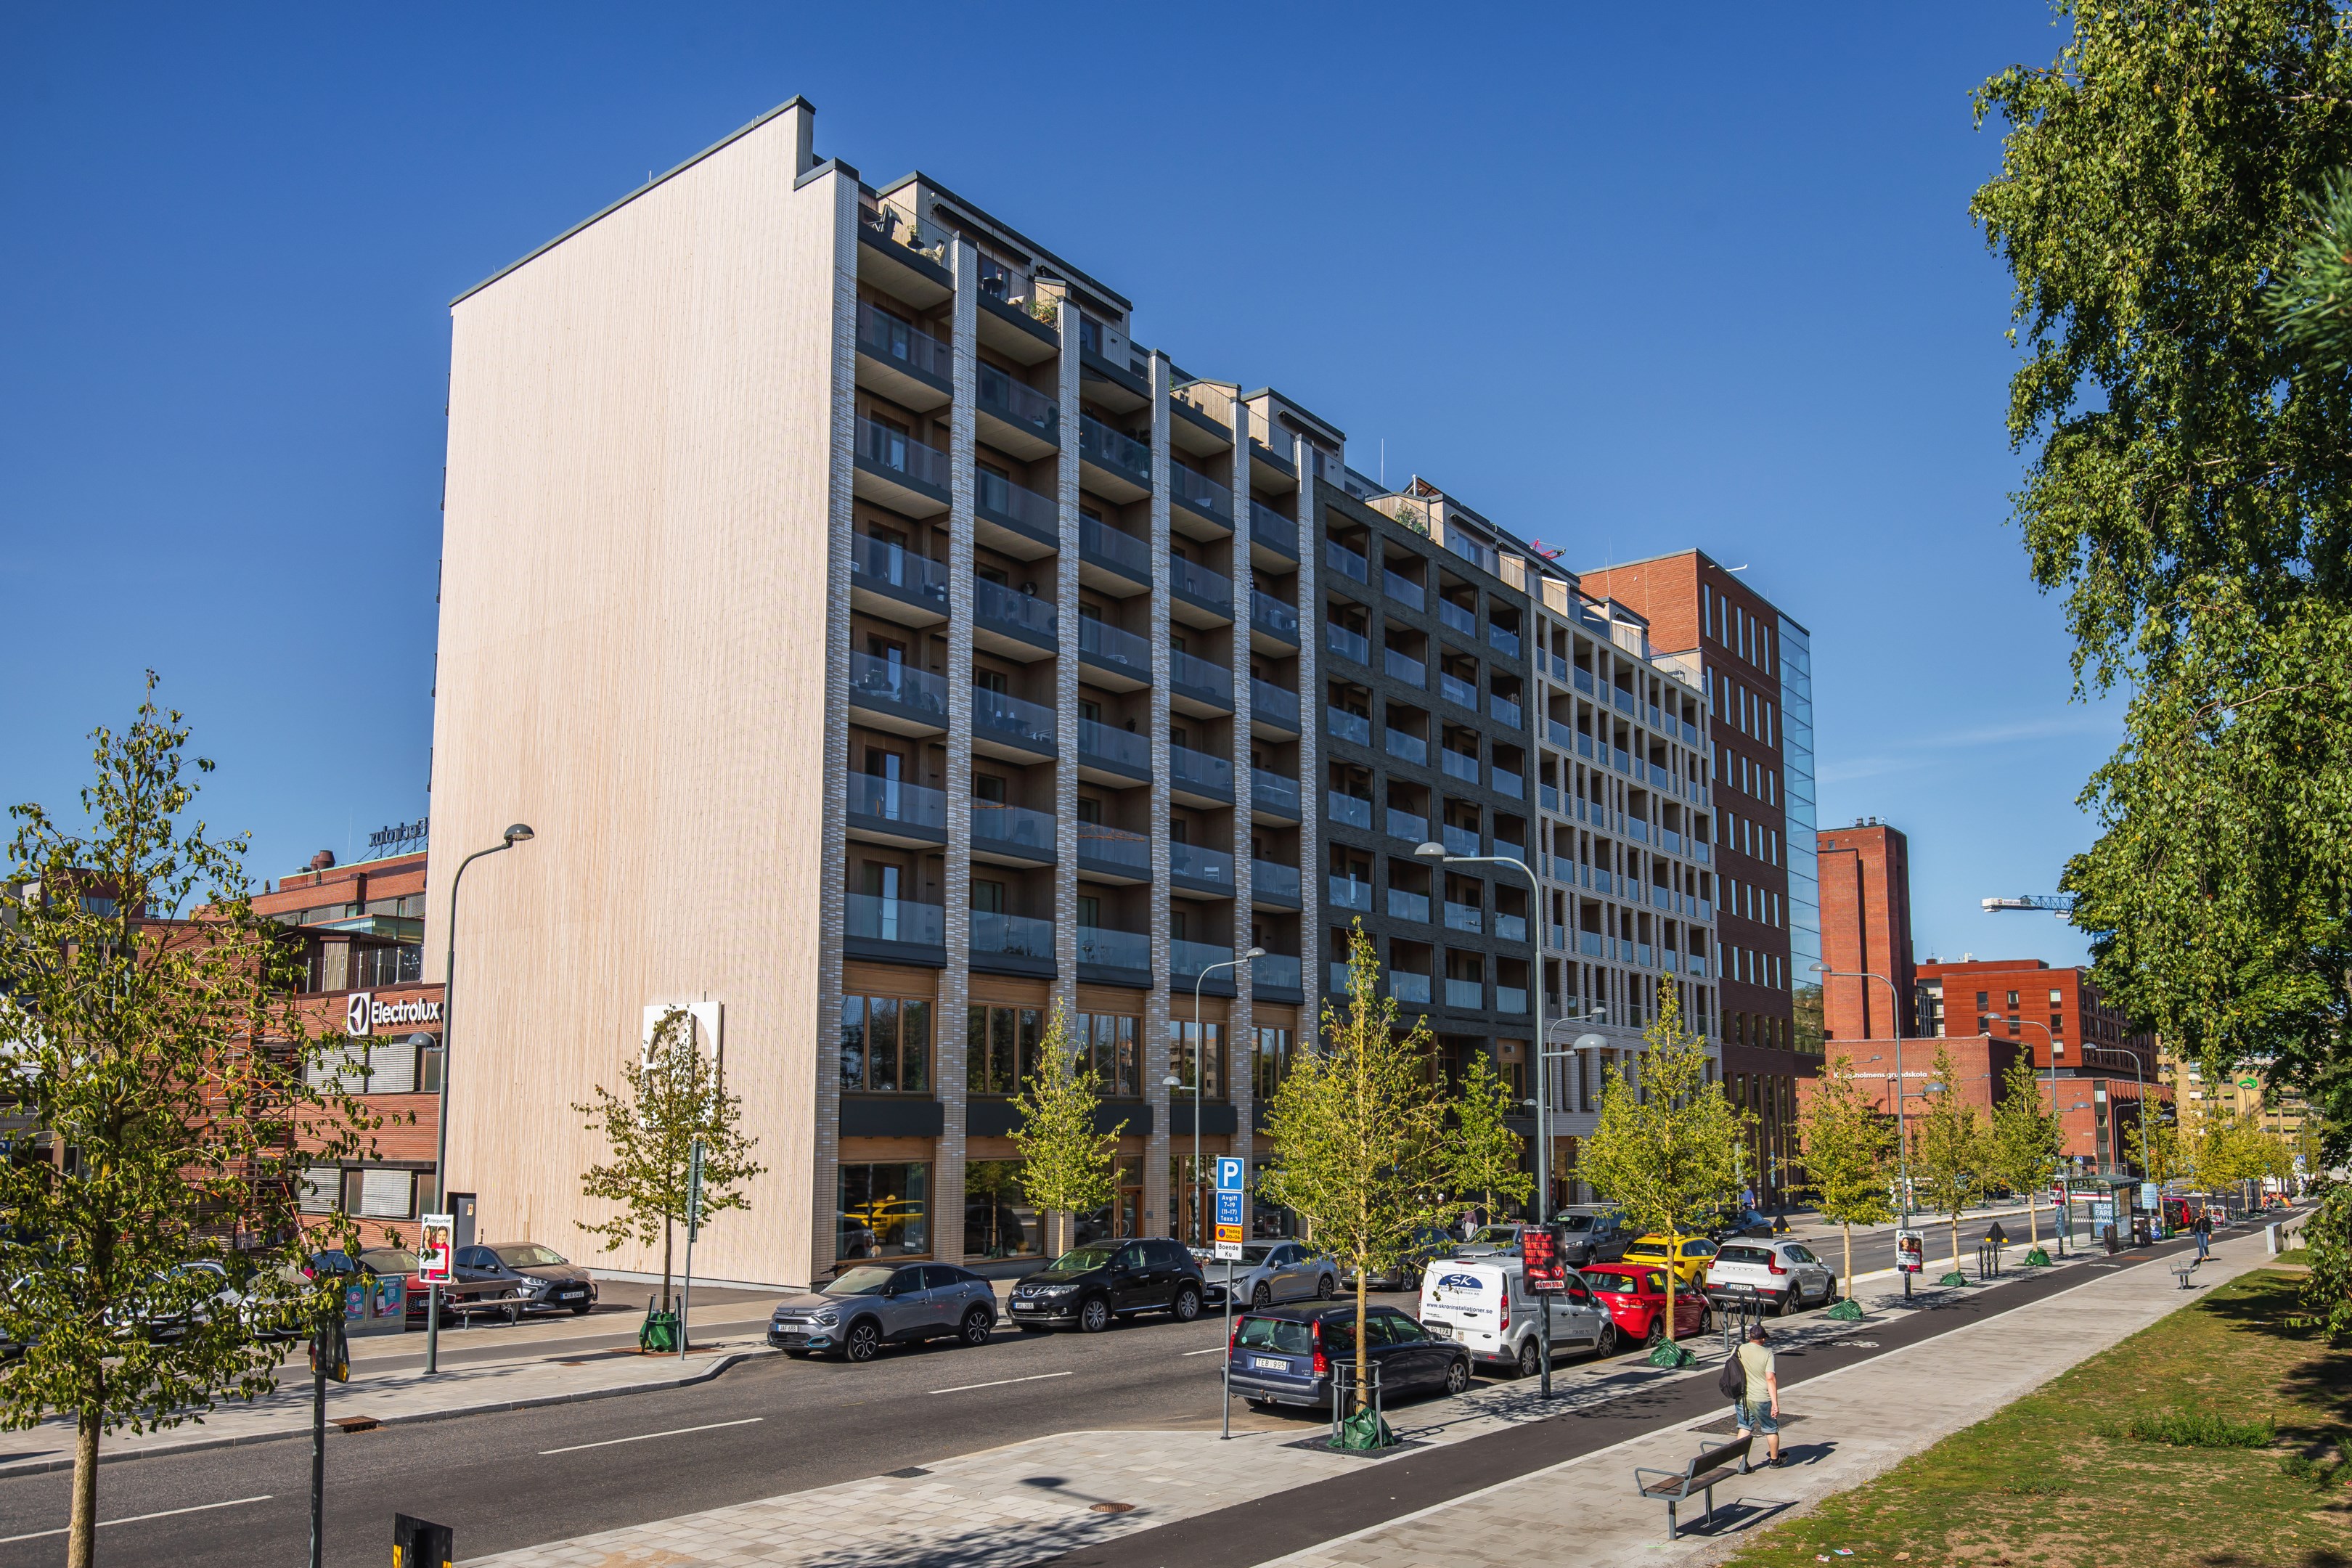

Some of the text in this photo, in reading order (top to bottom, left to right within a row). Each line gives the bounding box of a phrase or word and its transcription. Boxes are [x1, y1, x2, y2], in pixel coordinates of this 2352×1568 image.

[371, 997, 439, 1024] Electrolux
[1223, 1161, 1238, 1187] P
[1446, 1275, 1473, 1286] SK
[1426, 1303, 1493, 1315] www.skrorinstallationer.se
[1273, 1360, 1285, 1369] 995
